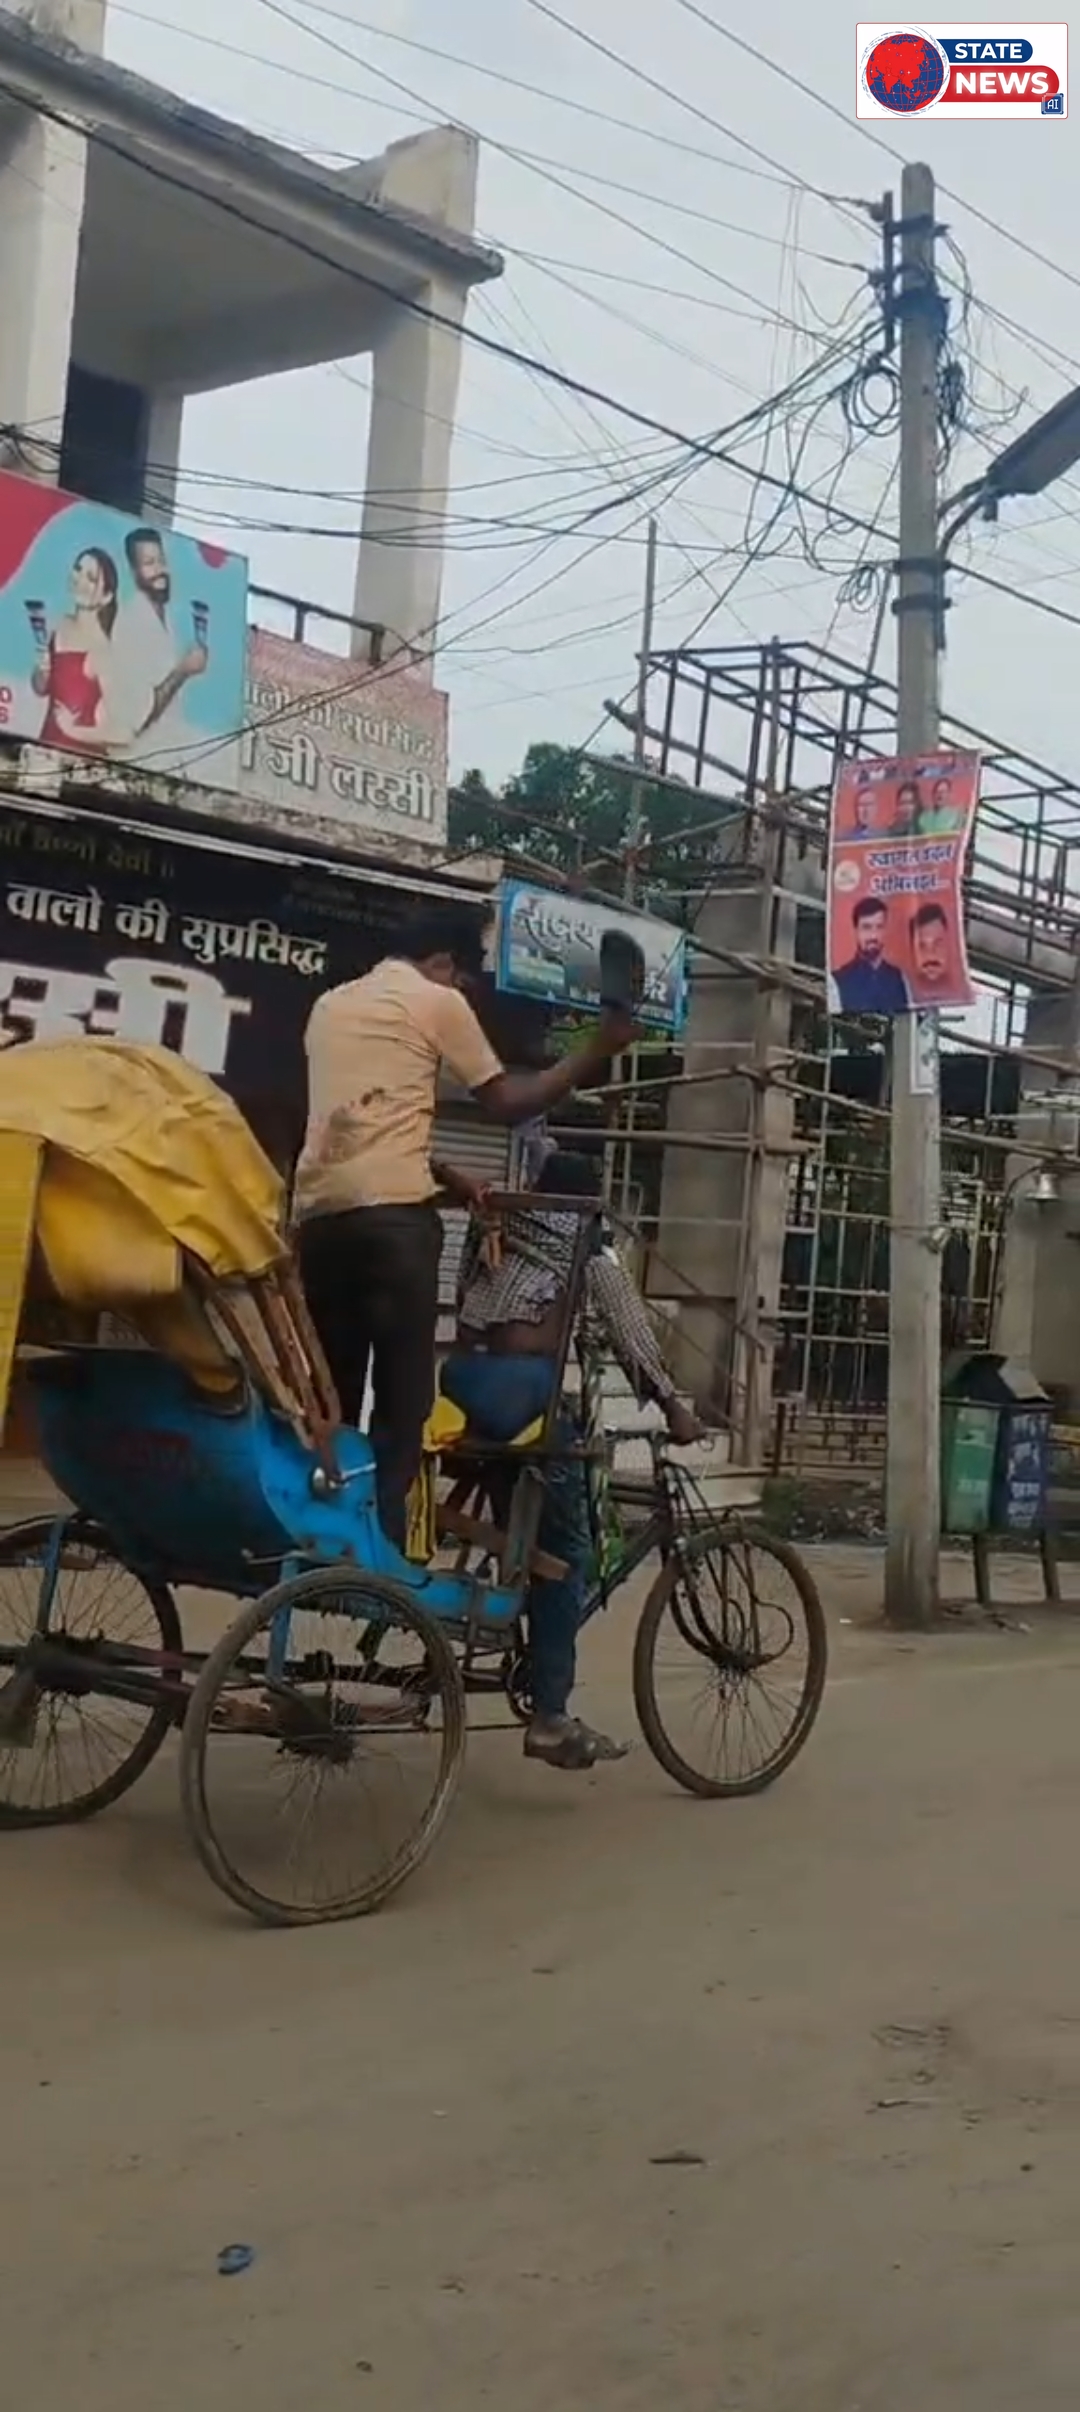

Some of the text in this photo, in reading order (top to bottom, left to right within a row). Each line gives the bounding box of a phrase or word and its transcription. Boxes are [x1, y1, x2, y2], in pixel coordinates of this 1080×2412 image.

[266, 731, 323, 790] जी
[329, 753, 436, 822] लस्सी
[6, 882, 328, 977] वालो की सुप्रसिद्ध
